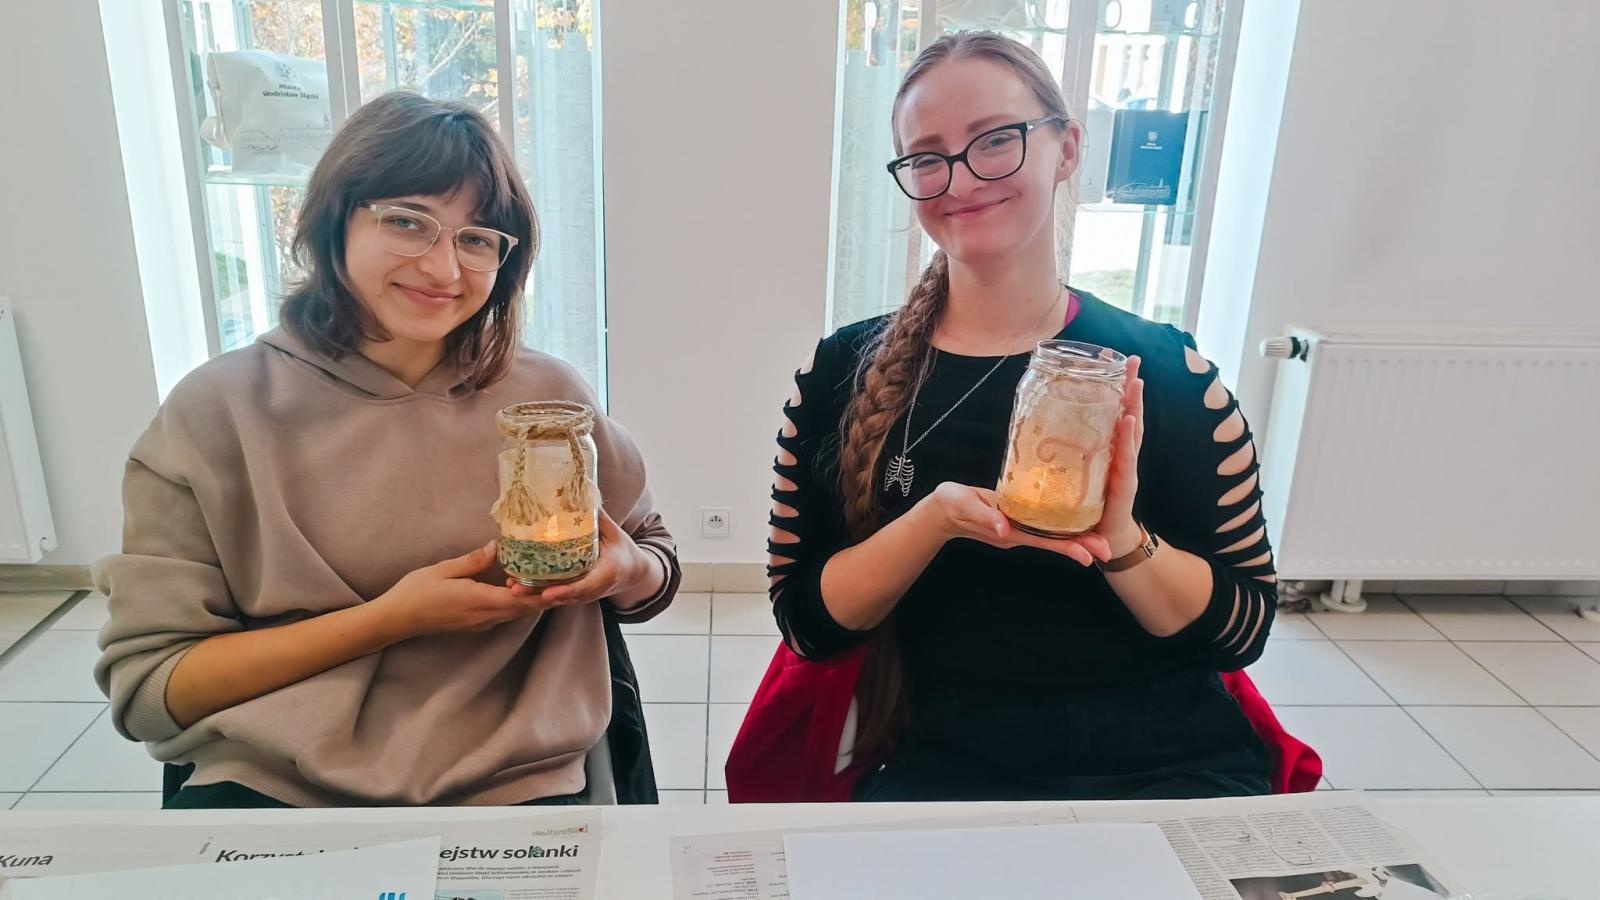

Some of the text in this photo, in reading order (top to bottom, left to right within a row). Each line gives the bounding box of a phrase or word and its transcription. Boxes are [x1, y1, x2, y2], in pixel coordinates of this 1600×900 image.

[278, 83, 302, 91] Miasto
[439, 846, 500, 862] ejstw
[502, 845, 579, 859] solanki
[0, 855, 54, 868] Kuna
